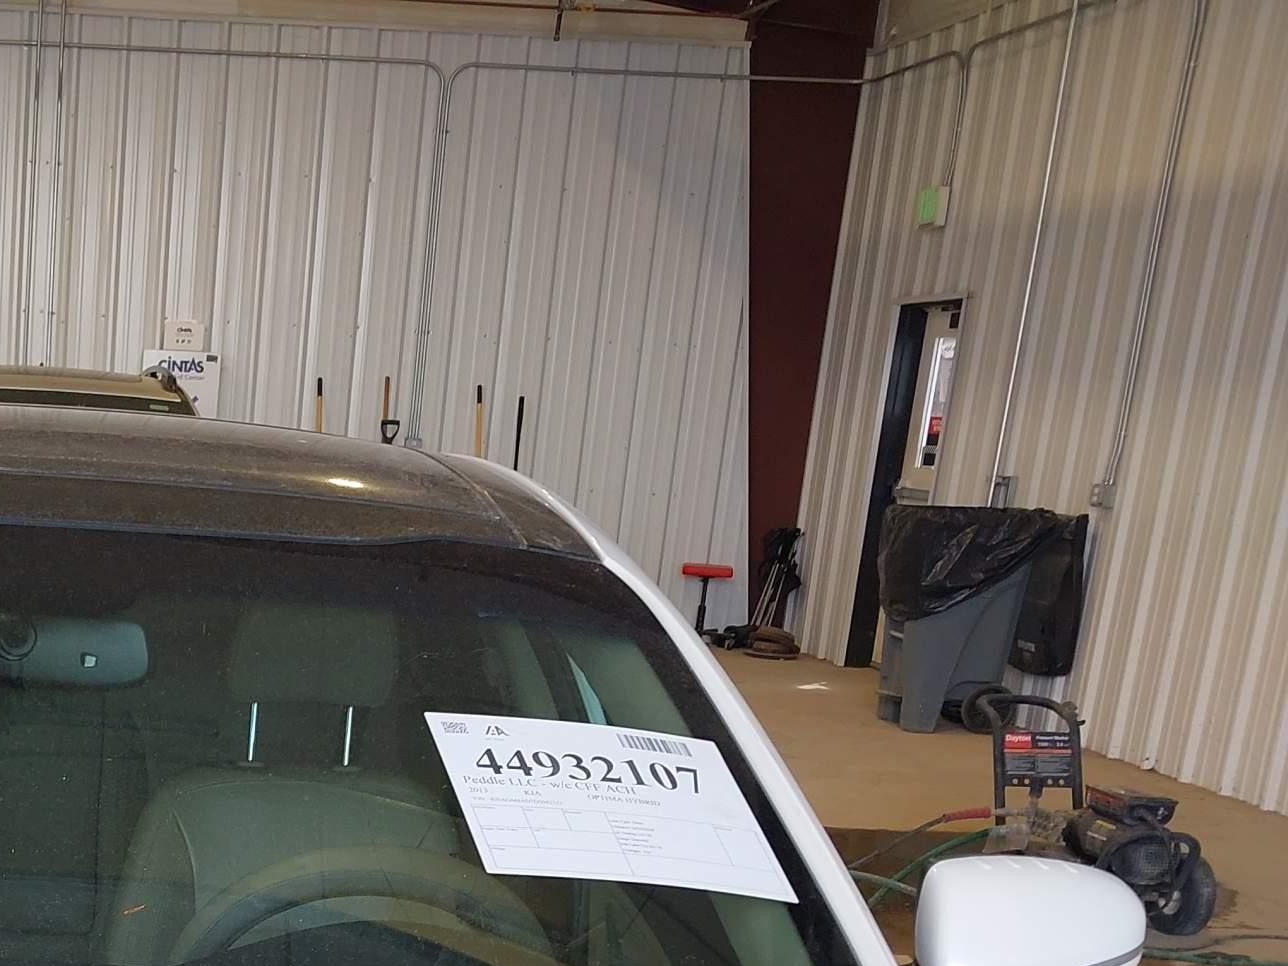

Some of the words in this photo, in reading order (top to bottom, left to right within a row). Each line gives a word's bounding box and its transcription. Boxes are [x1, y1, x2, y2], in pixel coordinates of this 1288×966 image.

[463, 775, 505, 786] Peddle
[508, 778, 536, 787] LLC
[476, 748, 699, 794] 44932107
